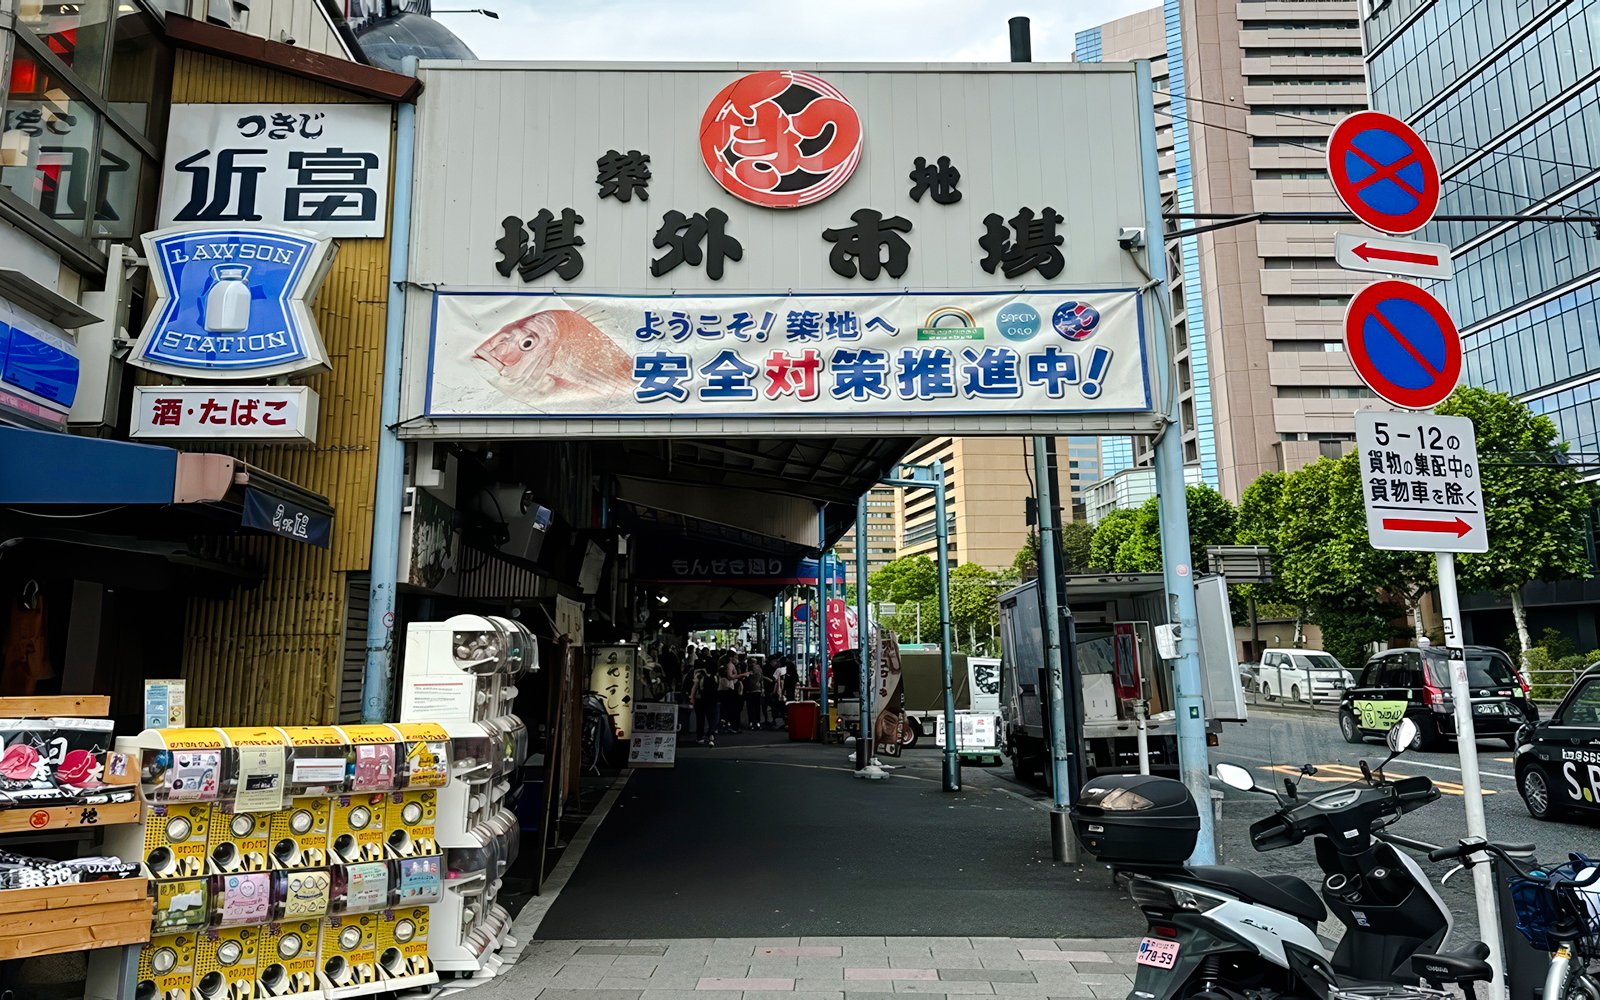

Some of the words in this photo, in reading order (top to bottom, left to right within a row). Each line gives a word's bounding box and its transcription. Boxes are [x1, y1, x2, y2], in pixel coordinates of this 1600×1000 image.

[237, 113, 325, 140] つきじ
[173, 148, 379, 221] 近富
[171, 242, 294, 264] LAWSON
[636, 310, 778, 344] ようこそ!
[786, 310, 899, 343] 築地へ
[163, 330, 287, 354] STATION
[633, 347, 1114, 403] 安全対策推進中!
[152, 397, 289, 427] 酒・たばこ
[1368, 449, 1473, 479] 貨物の集配中の
[1370, 478, 1478, 507] 貨物車を除く
[80, 807, 99, 824] 地
[1145, 949, 1174, 965] 78-59
